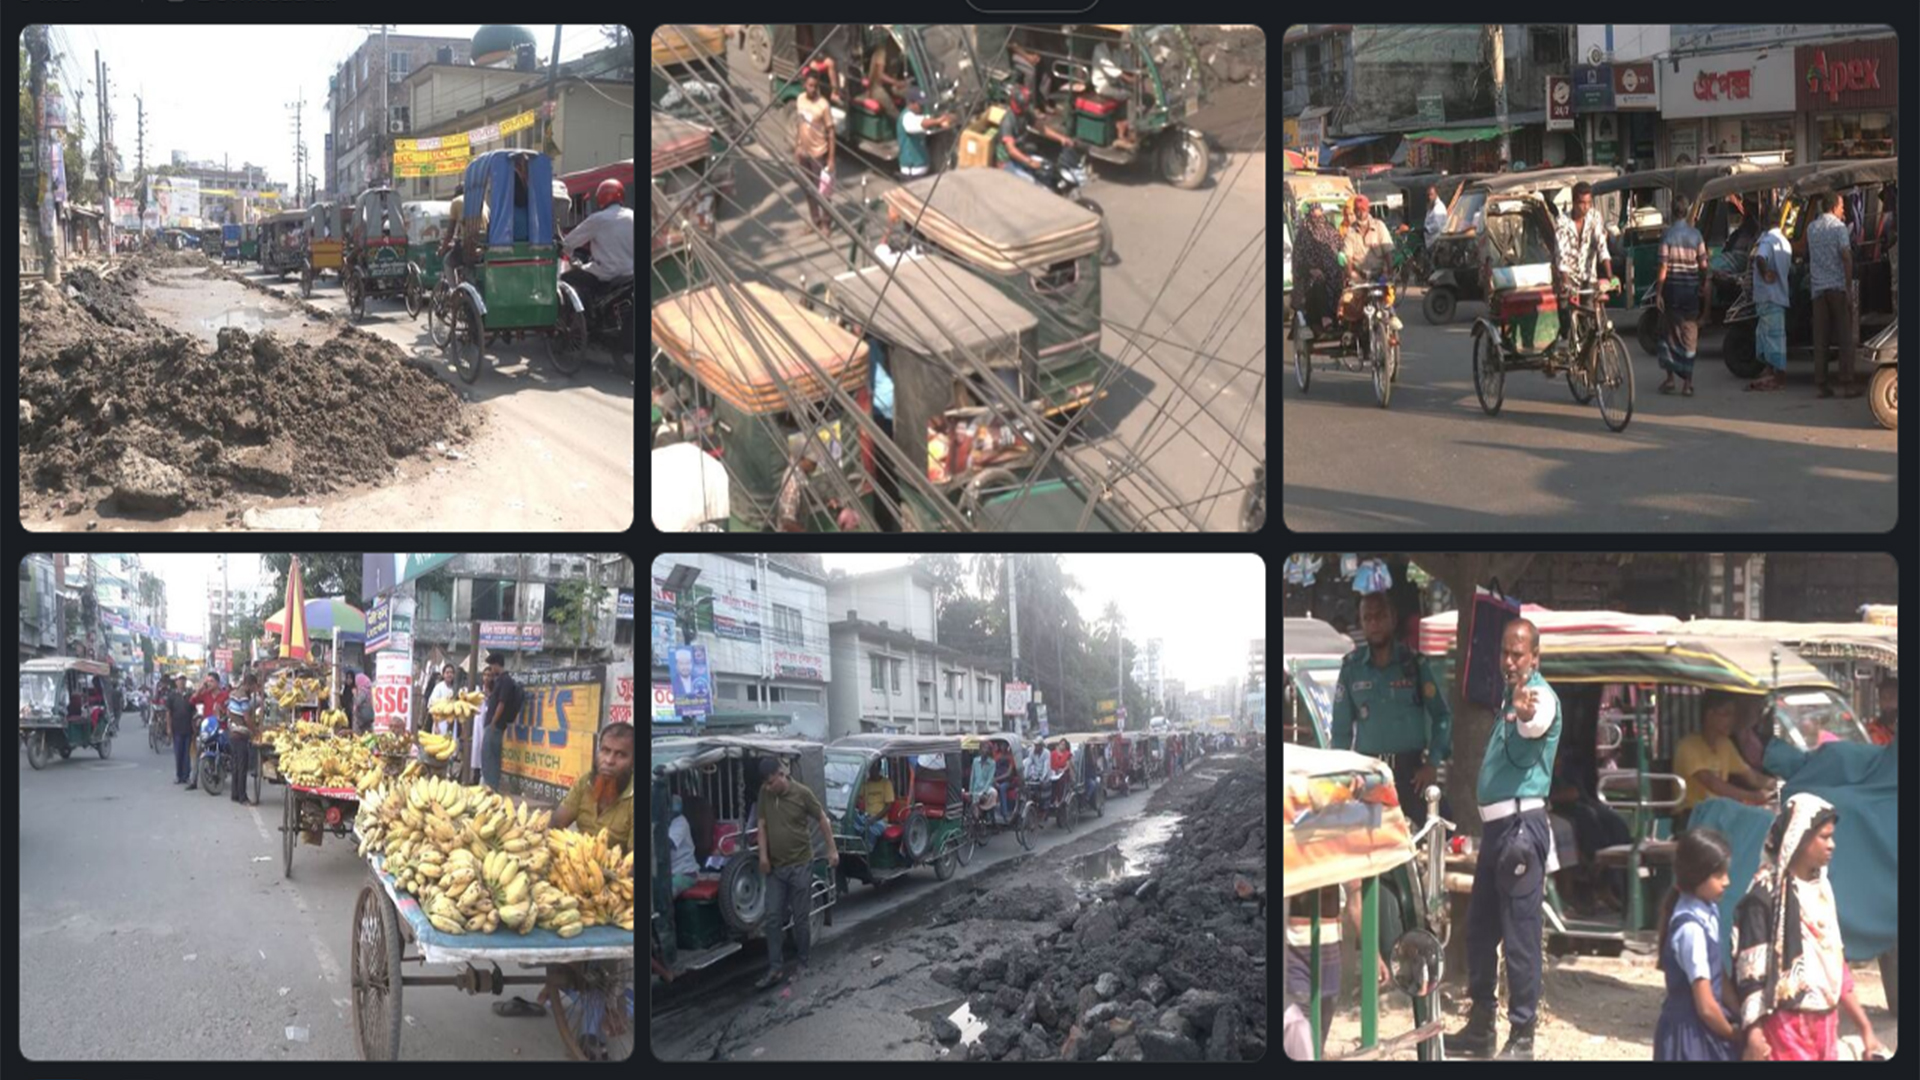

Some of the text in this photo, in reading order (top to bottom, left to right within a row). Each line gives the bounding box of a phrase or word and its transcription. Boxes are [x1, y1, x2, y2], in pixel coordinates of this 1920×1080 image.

[1693, 68, 1752, 102] এপেক্স
[1807, 49, 1880, 102] Apex
[395, 153, 413, 163] UCC
[374, 685, 409, 714] SSC
[524, 751, 561, 770] BATCH
